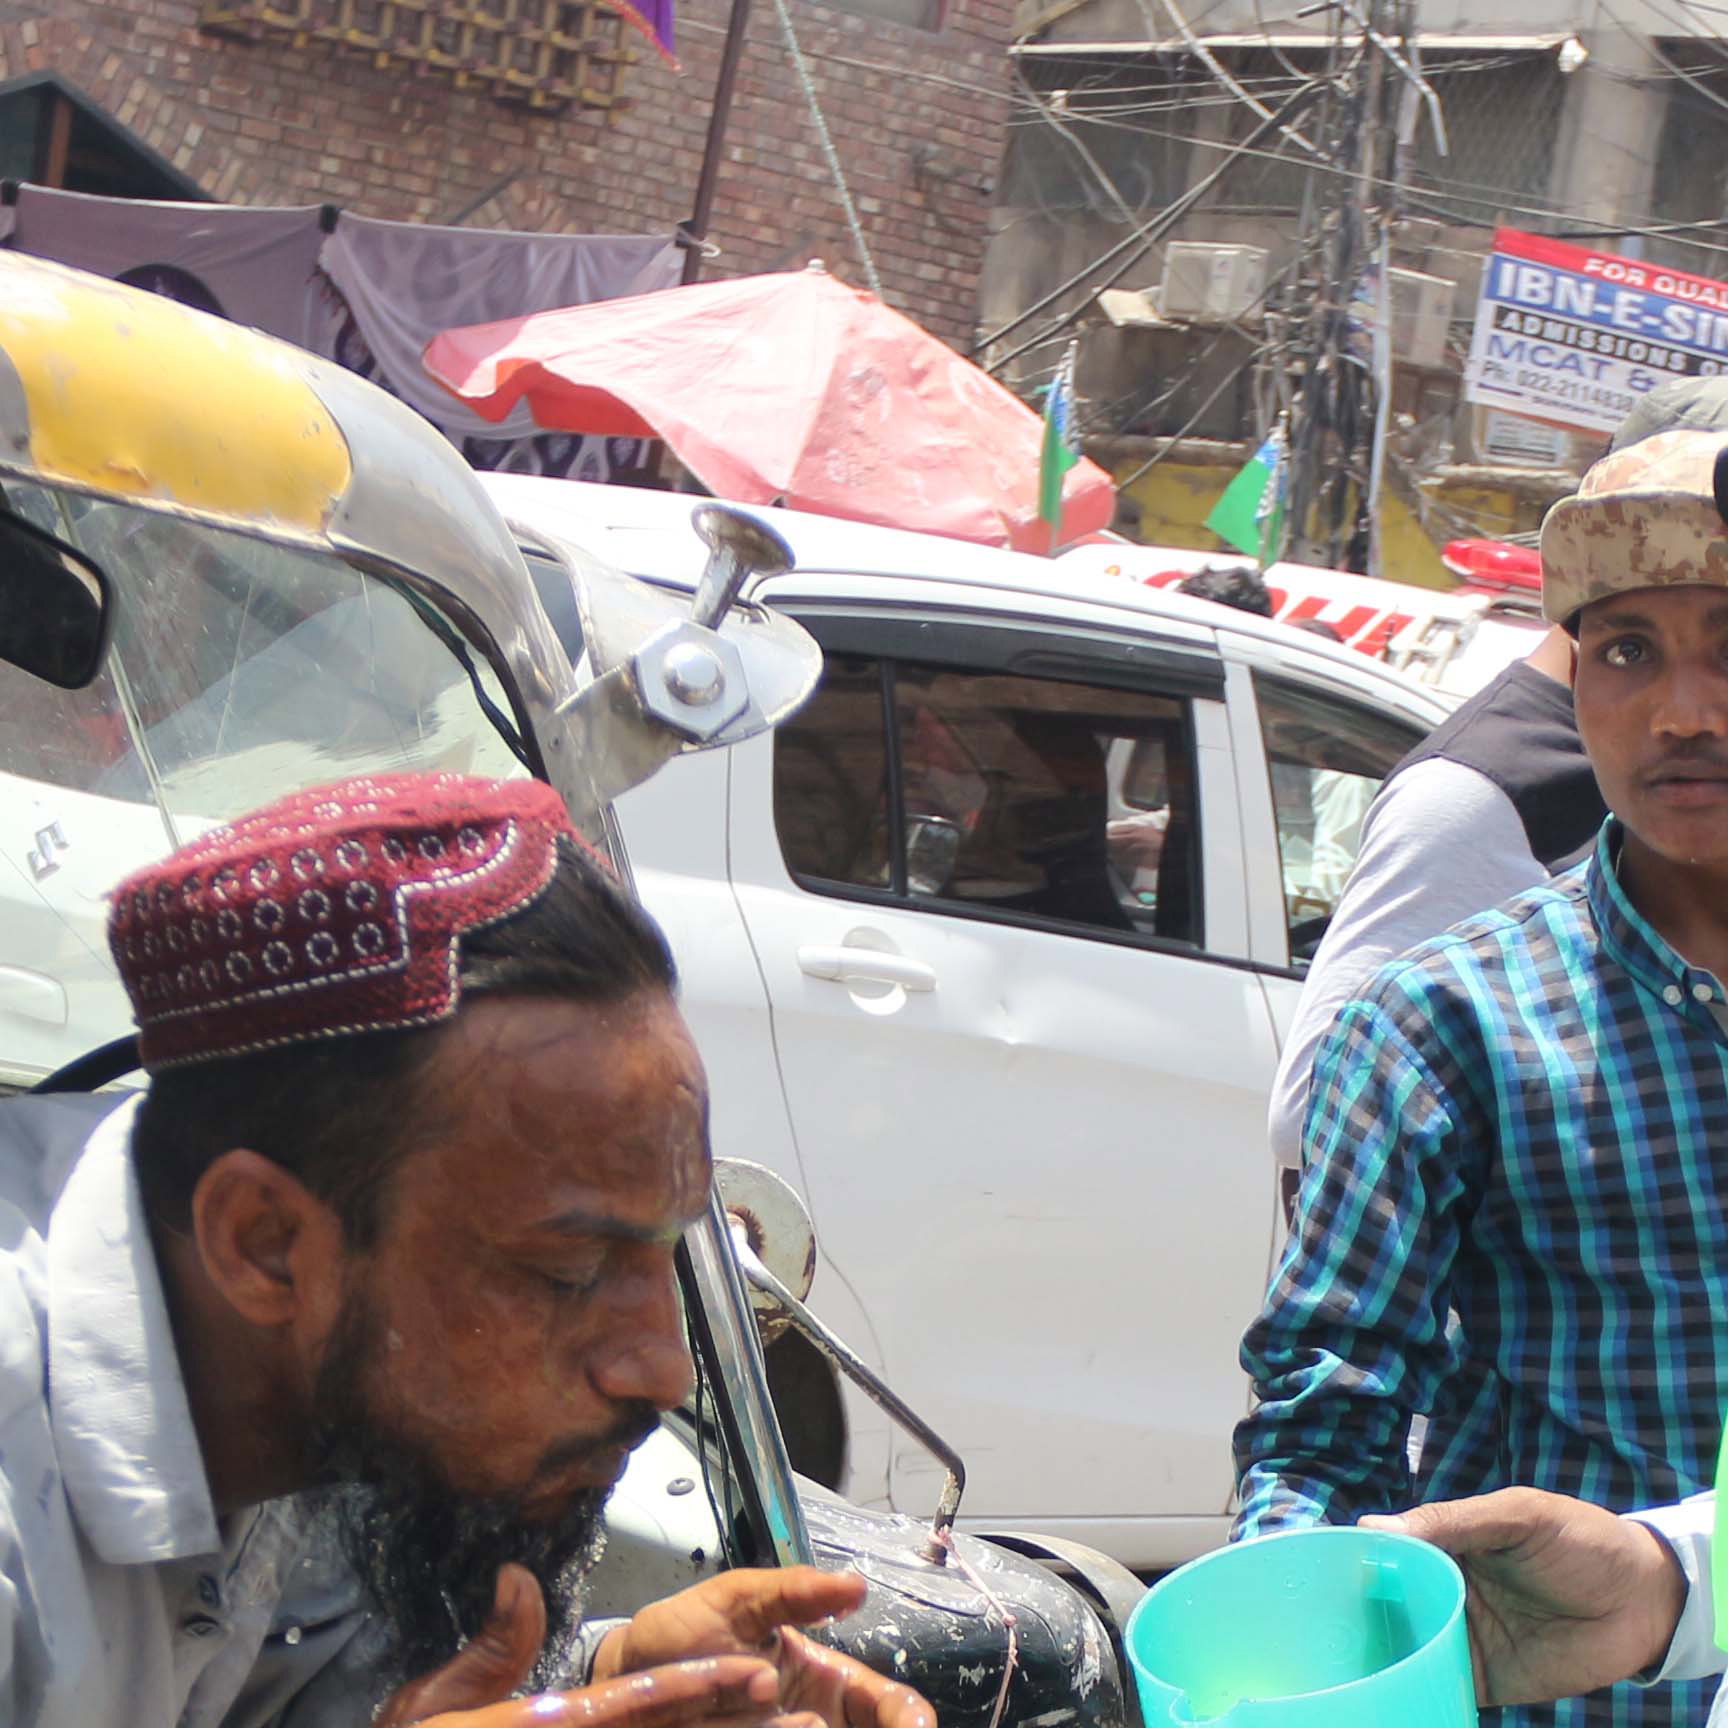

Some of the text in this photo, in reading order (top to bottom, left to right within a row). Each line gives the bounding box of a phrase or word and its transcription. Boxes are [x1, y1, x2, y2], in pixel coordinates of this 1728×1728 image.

[1584, 257, 1647, 287] FOR
[1486, 334, 1657, 392] MCAT &
[1502, 311, 1687, 371] ADMISSIONS
